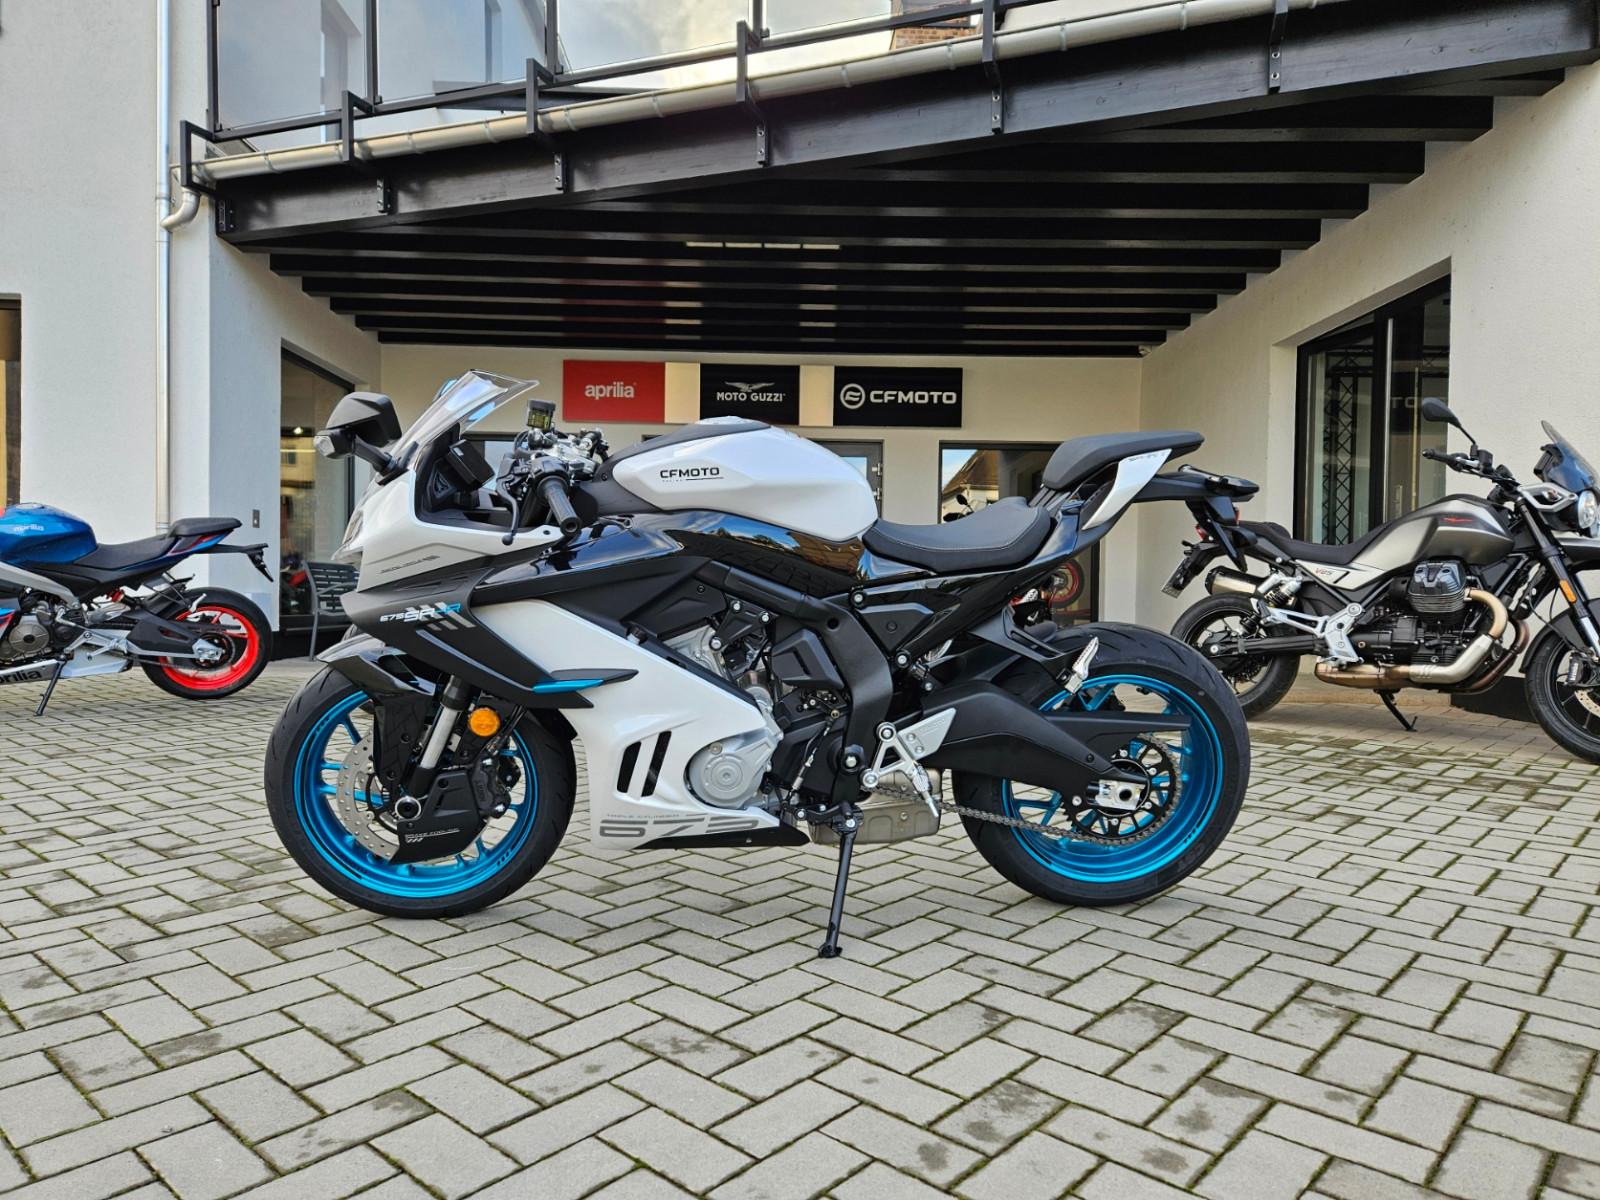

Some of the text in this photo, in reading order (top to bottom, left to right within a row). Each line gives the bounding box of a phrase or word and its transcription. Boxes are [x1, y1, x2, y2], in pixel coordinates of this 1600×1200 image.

[584, 381, 635, 400] aprilia
[716, 392, 783, 402] MOTO GUZZI
[870, 390, 957, 404] CFMOTO
[660, 467, 720, 479] CFMOTO
[0, 669, 42, 684] rilia
